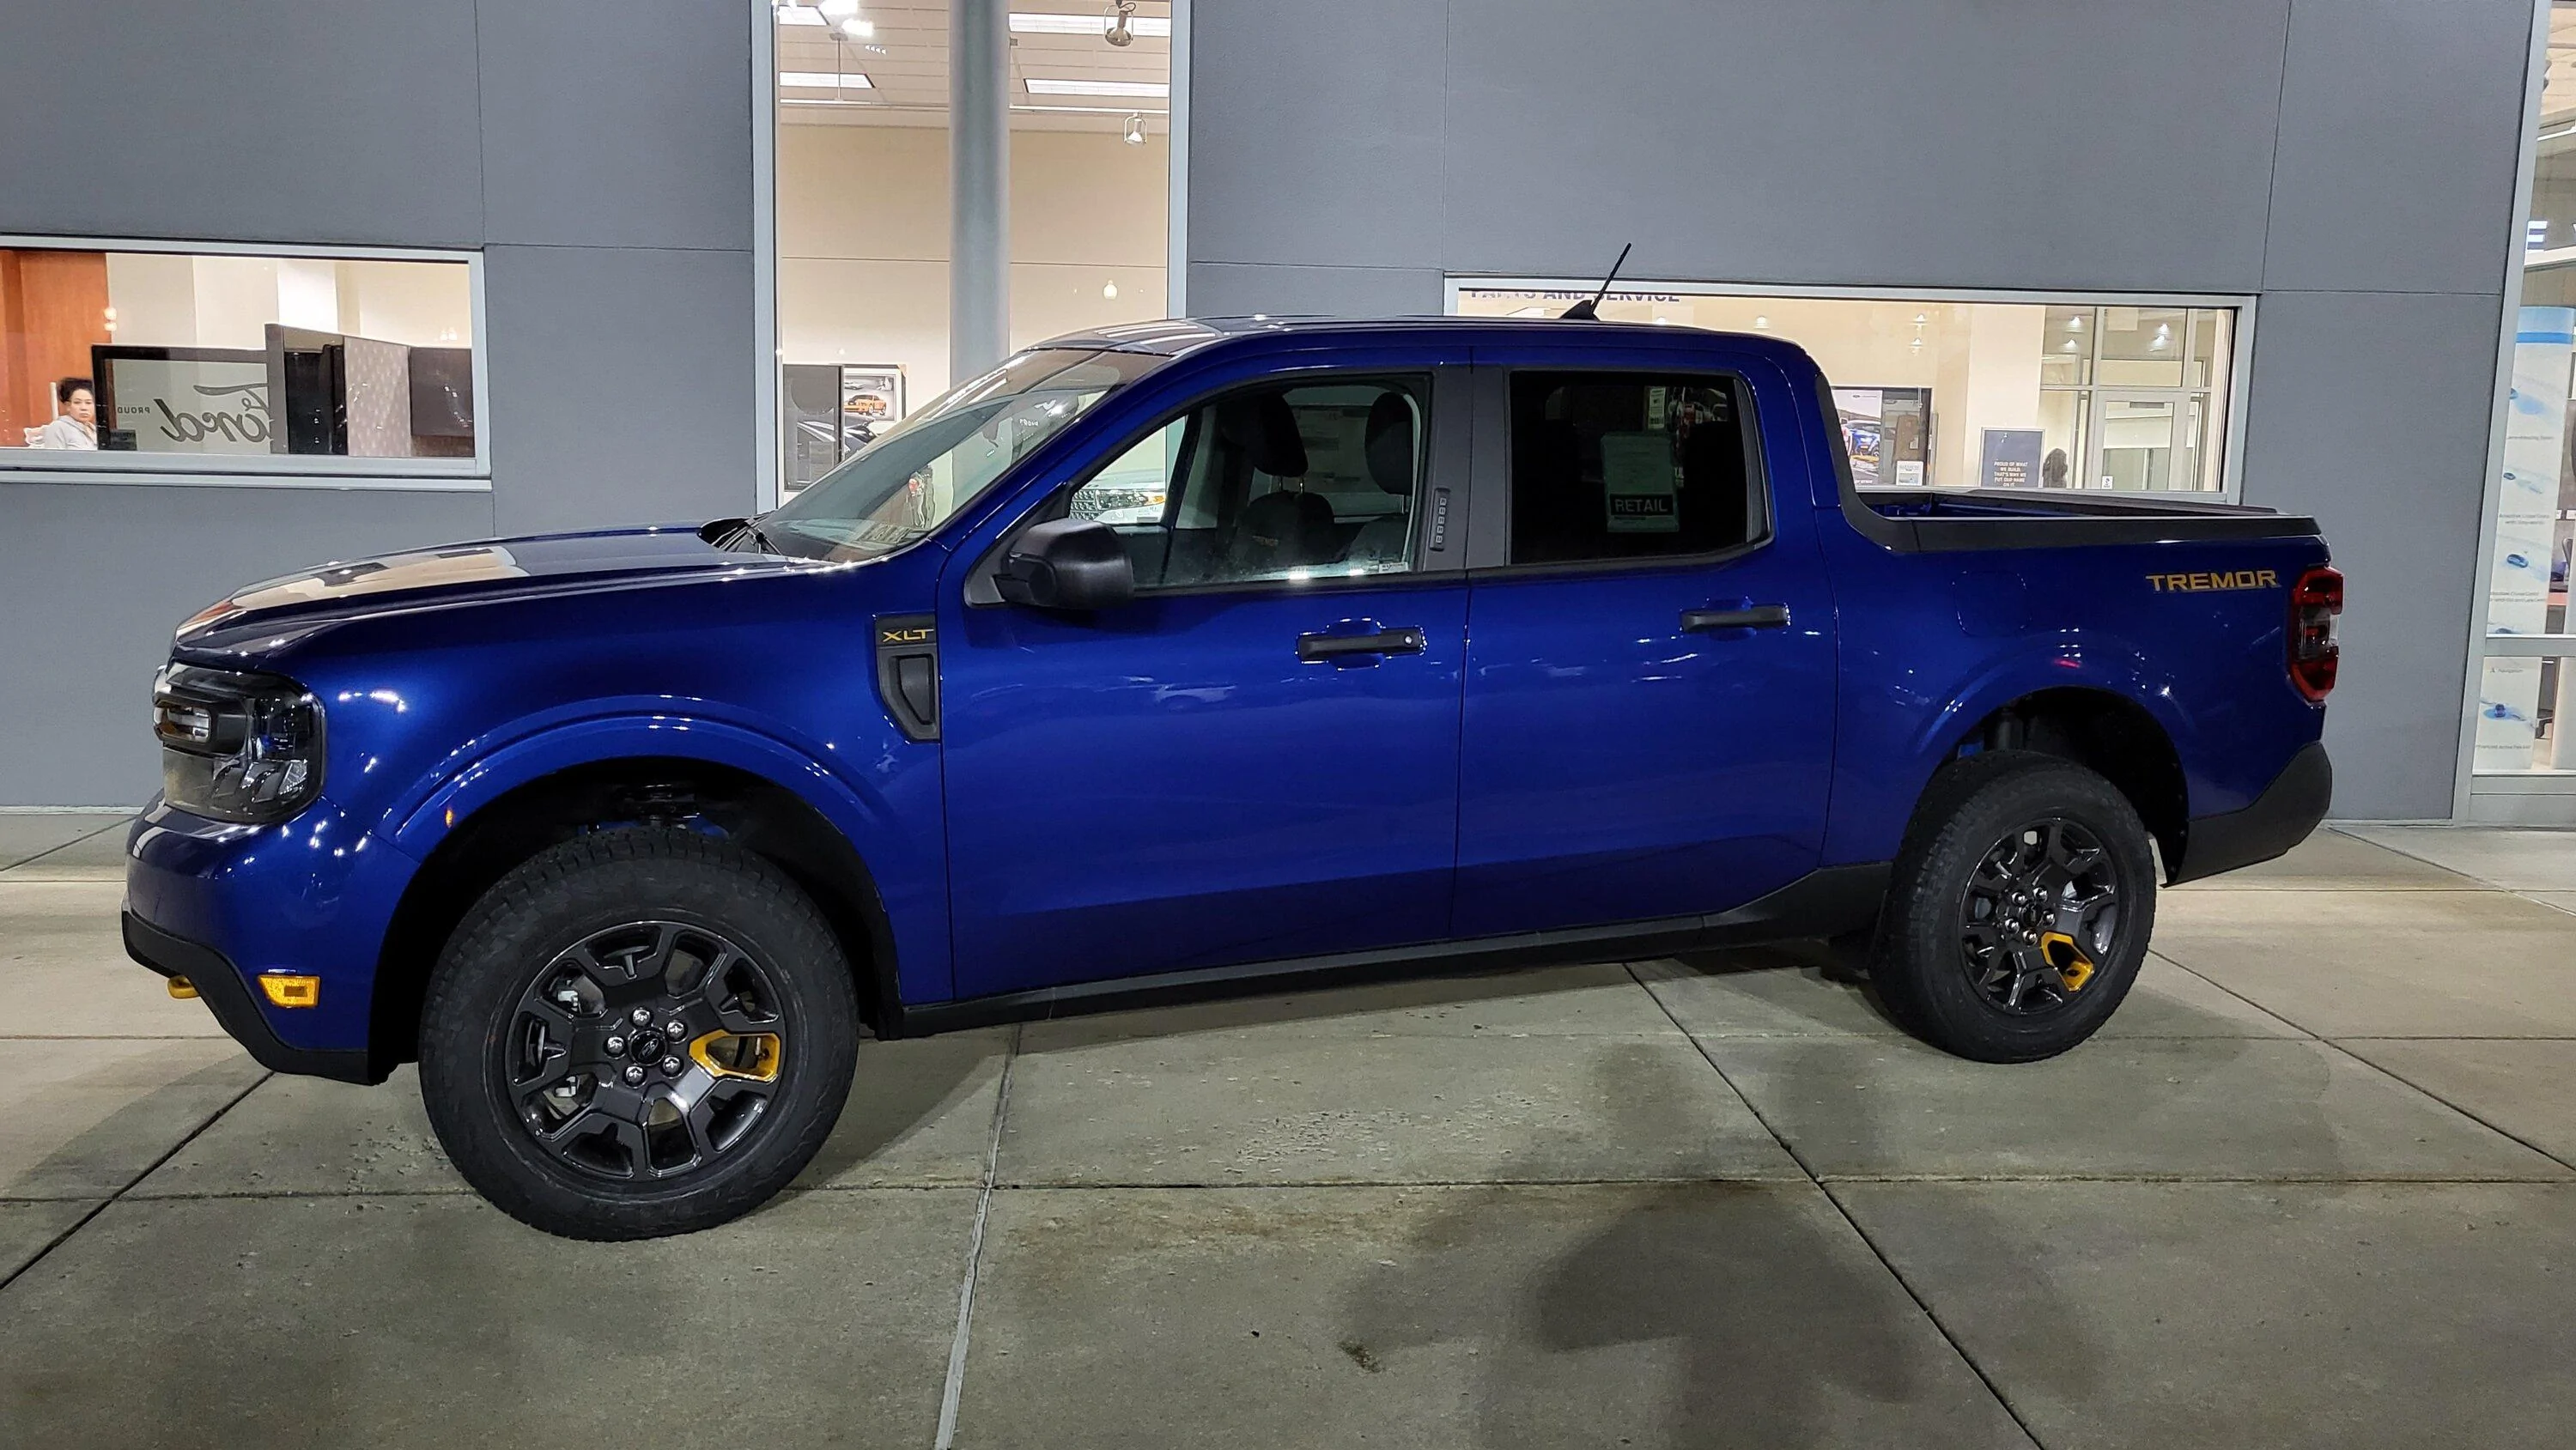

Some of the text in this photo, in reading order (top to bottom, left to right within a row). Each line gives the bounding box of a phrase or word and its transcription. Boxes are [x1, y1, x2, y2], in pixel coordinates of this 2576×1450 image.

[1614, 499, 1668, 513] RETAIL
[2145, 570, 2281, 592] TREMOR
[883, 628, 934, 642] XLT
